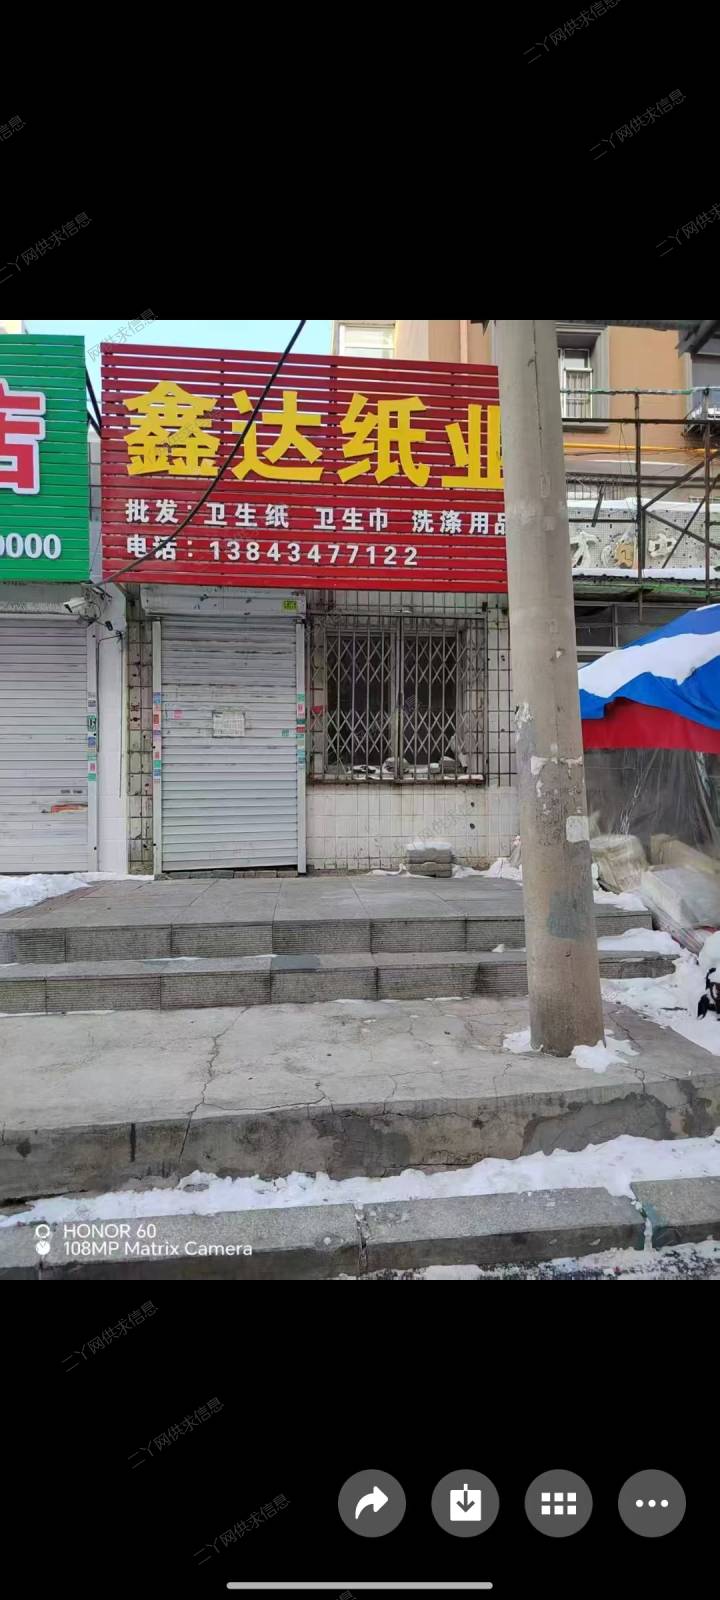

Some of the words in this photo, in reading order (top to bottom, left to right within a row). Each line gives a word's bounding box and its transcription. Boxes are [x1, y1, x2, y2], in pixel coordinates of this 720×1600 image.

[123, 379, 504, 489] 鑫达纸业
[313, 506, 389, 532] 卫生巾
